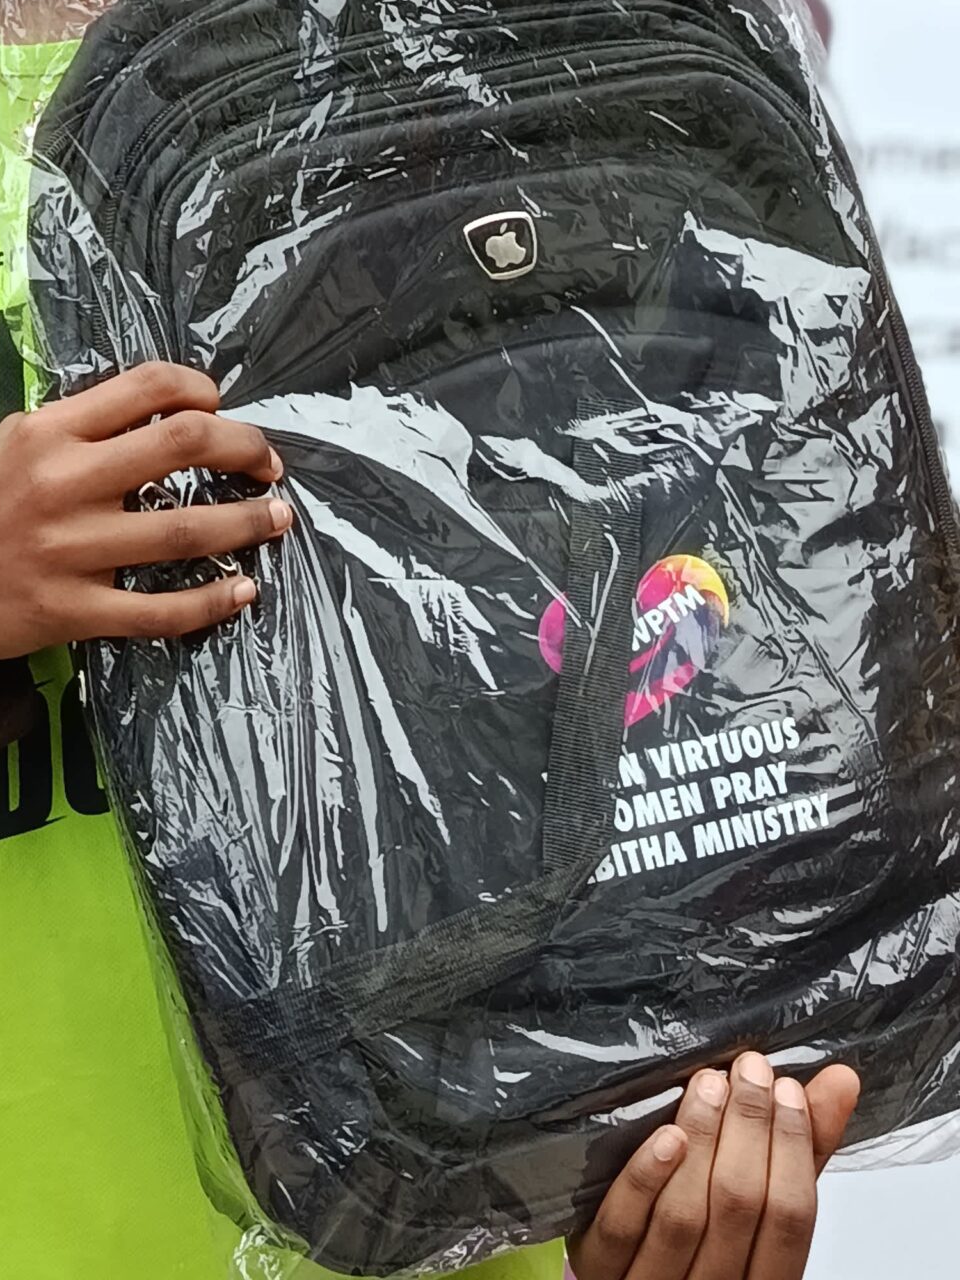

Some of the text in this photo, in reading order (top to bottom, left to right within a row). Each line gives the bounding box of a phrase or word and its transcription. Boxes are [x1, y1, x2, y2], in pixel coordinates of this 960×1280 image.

[649, 716, 800, 780] VIRTUOUS
[613, 761, 788, 832] OMEN PRAY
[587, 793, 830, 885] BITHA MINISTRY
